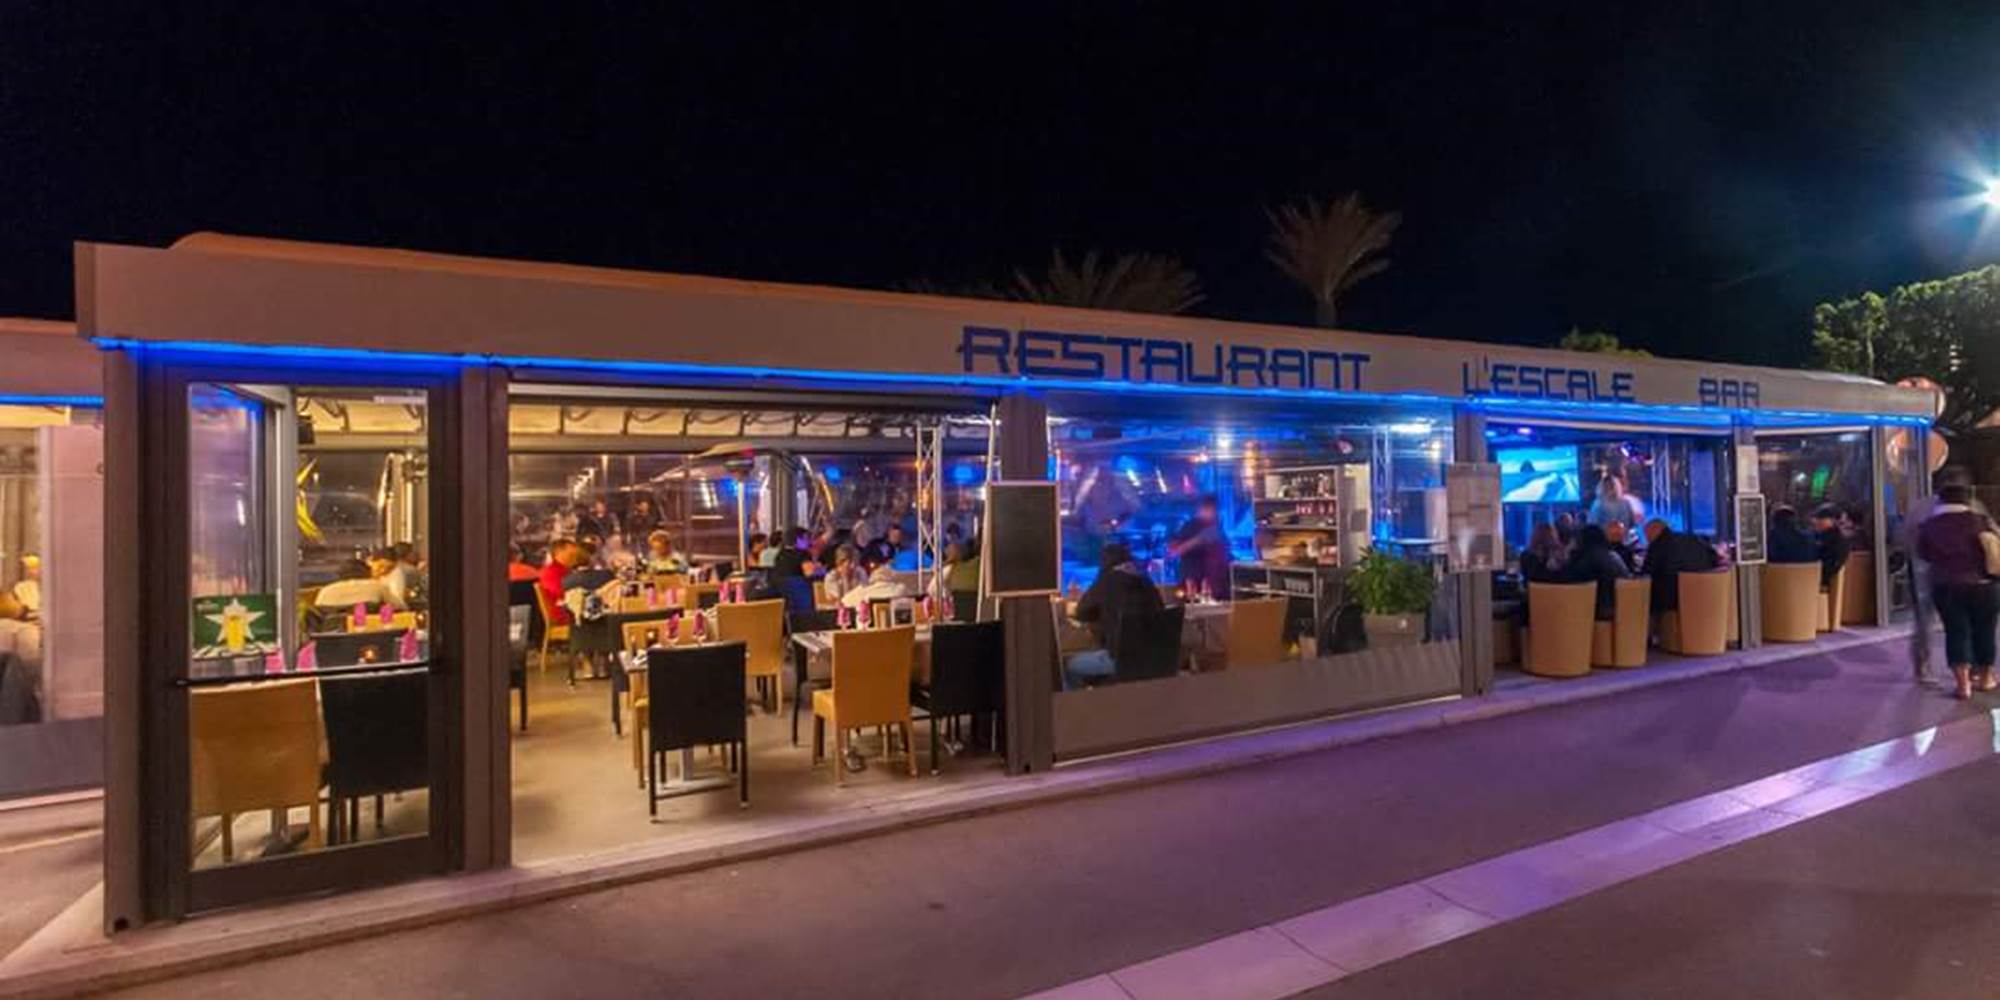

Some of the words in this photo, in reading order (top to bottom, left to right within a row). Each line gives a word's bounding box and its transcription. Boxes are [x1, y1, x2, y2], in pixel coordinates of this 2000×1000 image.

[956, 325, 1370, 391] RESTAURANT
[1462, 356, 1636, 402] L'ESCALE
[1698, 377, 1760, 408] BAR
